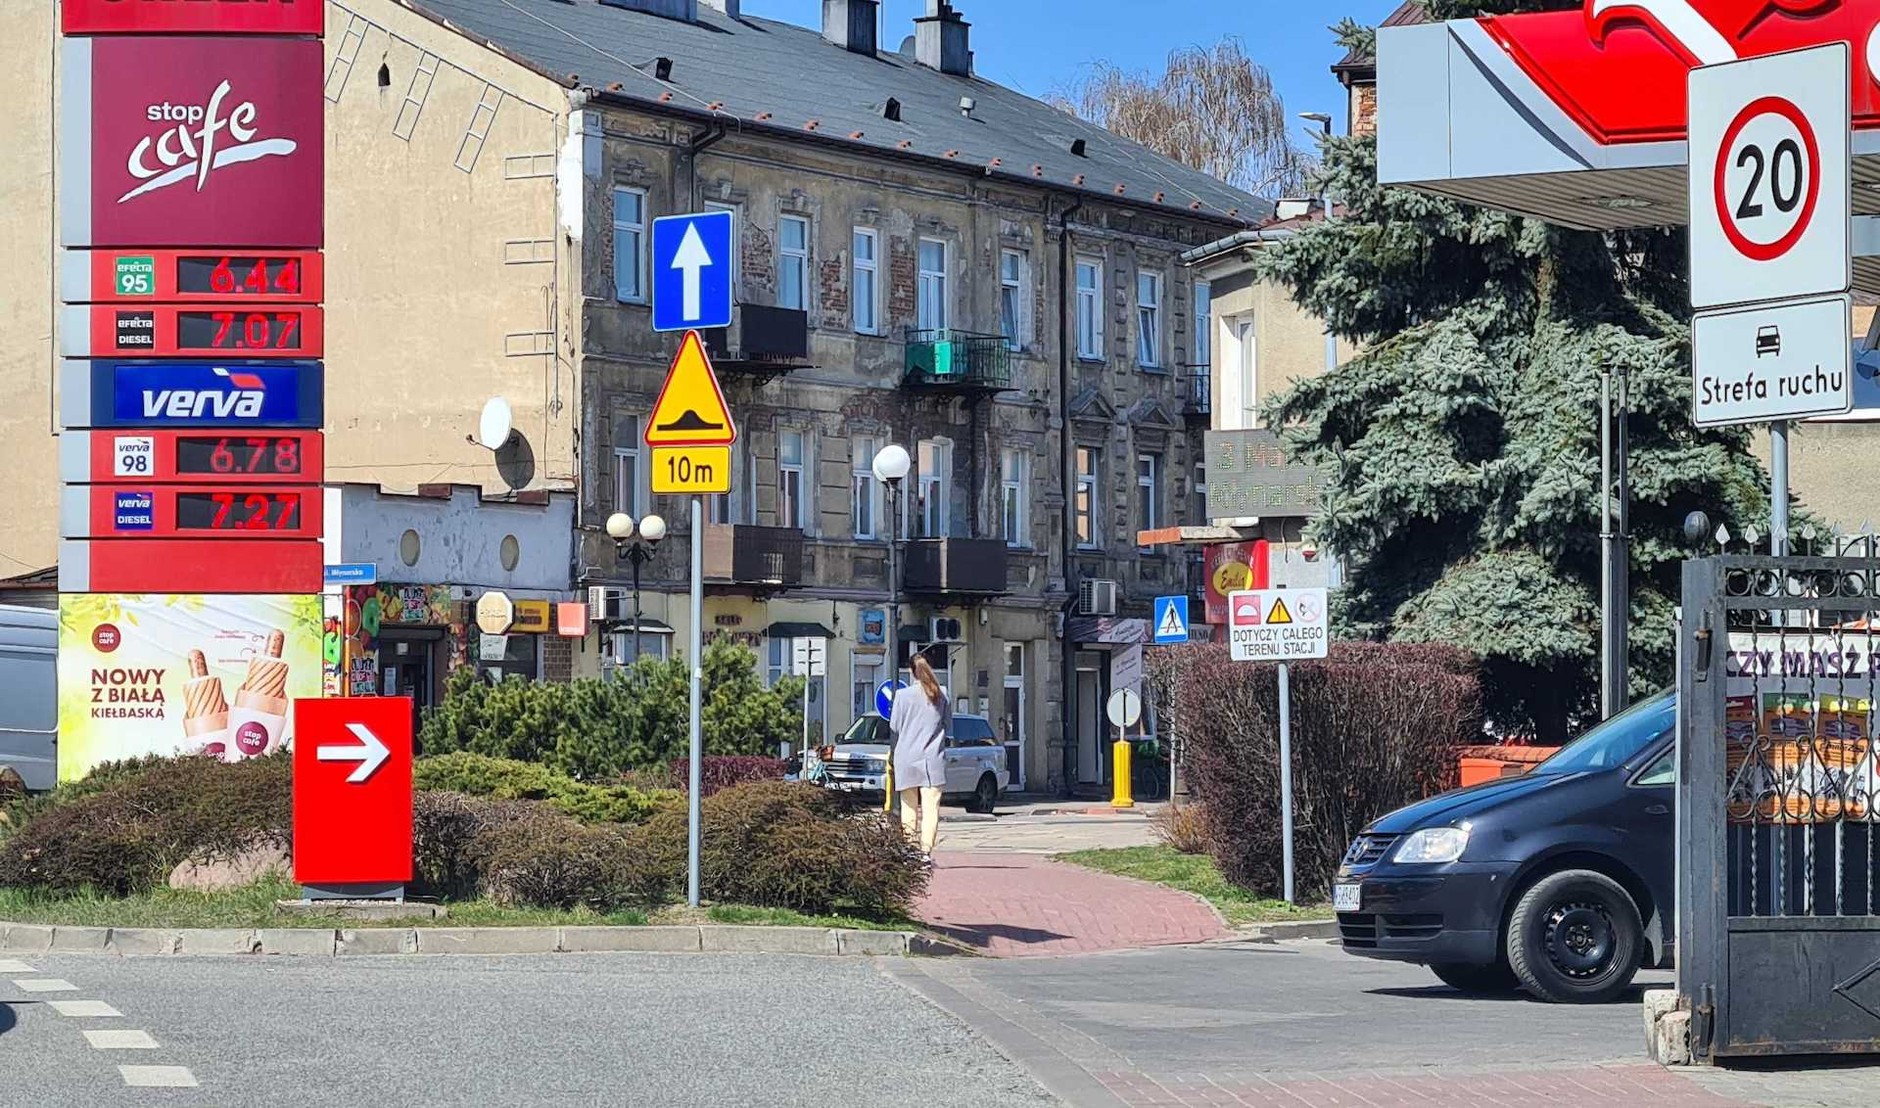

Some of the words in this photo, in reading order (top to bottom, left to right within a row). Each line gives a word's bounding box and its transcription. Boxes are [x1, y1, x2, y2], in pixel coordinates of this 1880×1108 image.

[147, 101, 204, 125] stop
[127, 79, 258, 192] cafe
[1736, 138, 1803, 219] 20
[121, 274, 148, 293] 95
[210, 257, 298, 294] 6.44
[118, 335, 152, 344] DIESEL
[211, 312, 299, 348] 7.07
[1700, 374, 1767, 405] Strefa
[1778, 364, 1843, 397] ruchu
[142, 390, 265, 418] verva
[118, 443, 150, 453] verva
[210, 438, 298, 473] 6.78
[122, 455, 148, 473] 98
[117, 498, 150, 509] verva
[211, 493, 299, 530] 7.27
[117, 515, 152, 525] DIESEL
[1233, 628, 1279, 642] DOTYCZY
[1242, 642, 1280, 657] TERENU
[1283, 641, 1316, 655] STACJI
[1780, 651, 1862, 679] MASZ
[91, 668, 167, 685] NOWY
[91, 688, 104, 703] Z
[108, 688, 166, 706] BIAŁĄ
[91, 706, 166, 720] KIEŁBASKĄ
